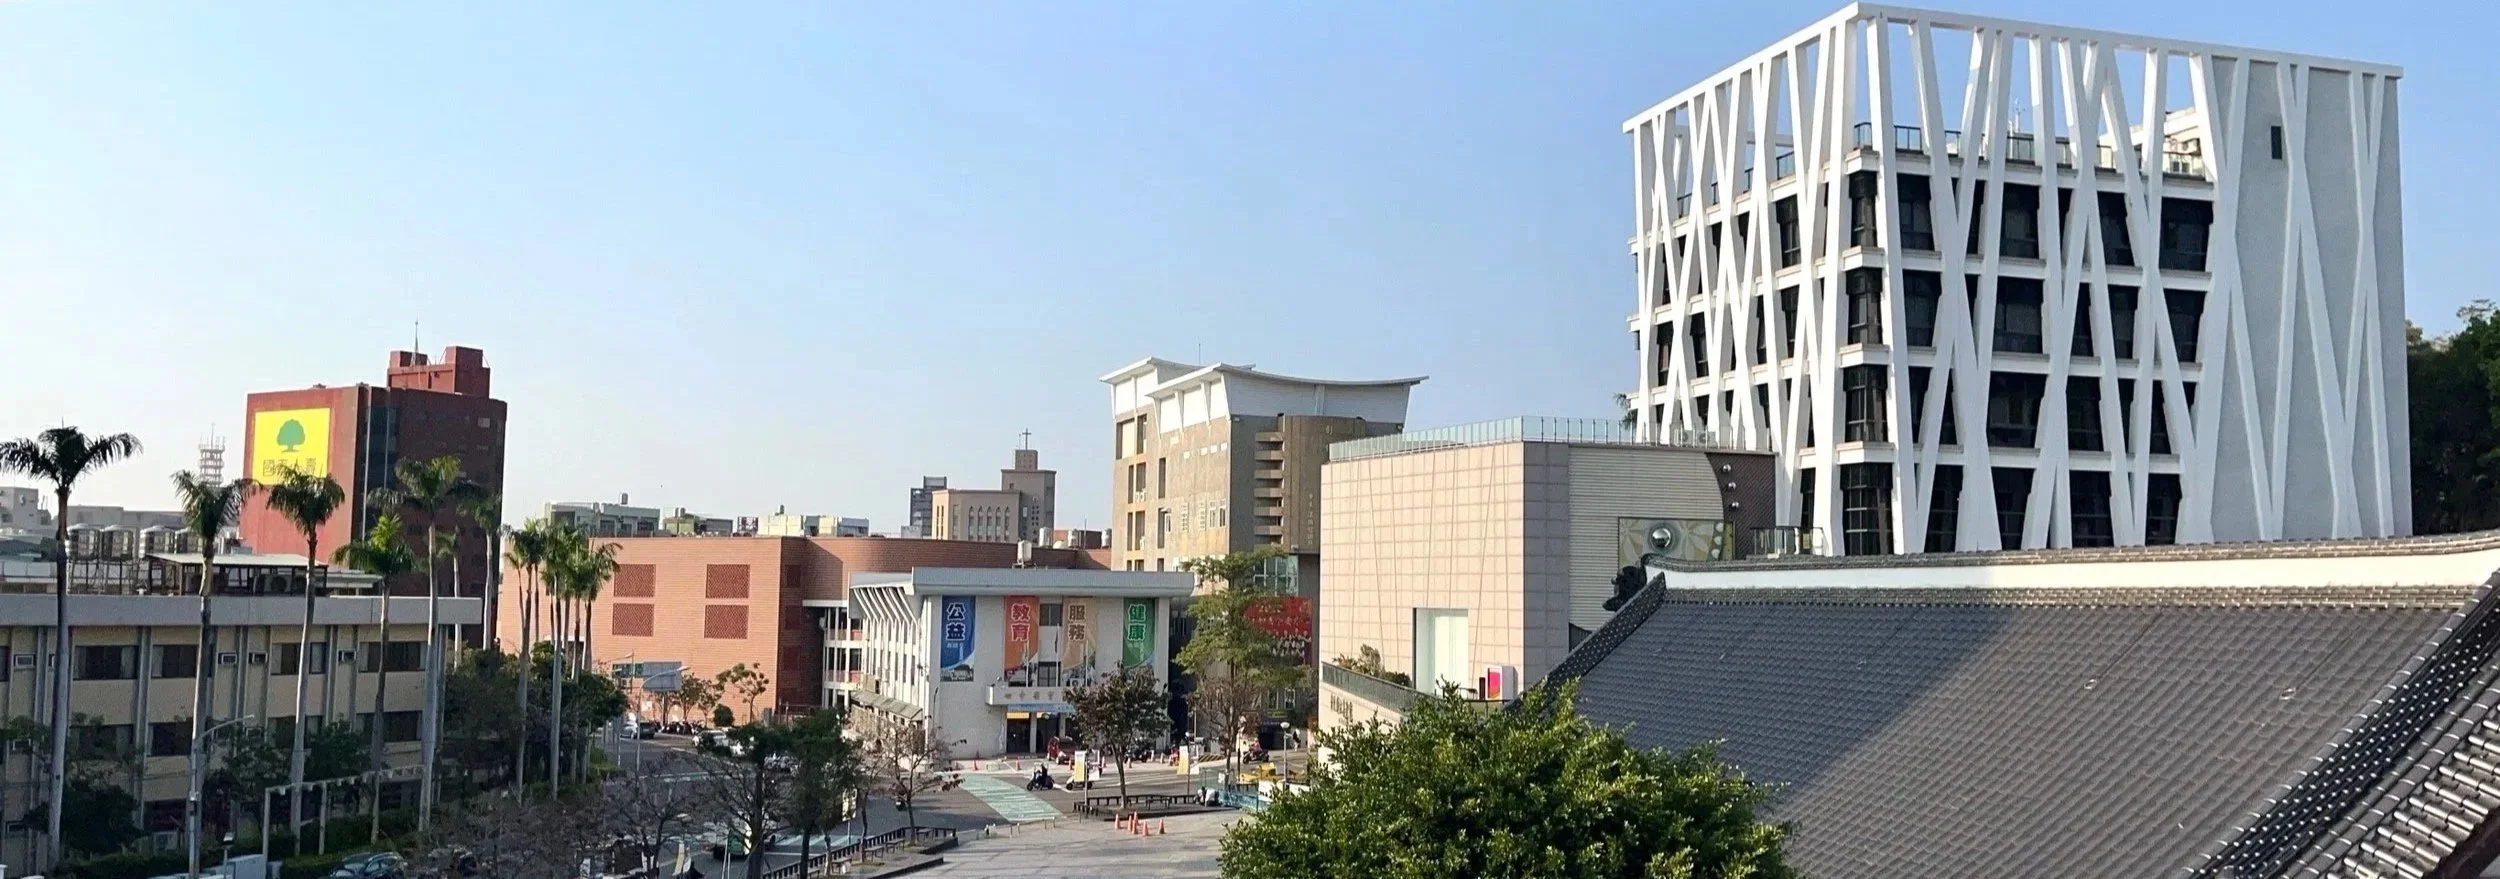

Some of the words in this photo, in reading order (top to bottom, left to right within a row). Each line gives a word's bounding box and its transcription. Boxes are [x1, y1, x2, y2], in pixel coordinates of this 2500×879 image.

[946, 602, 966, 641] 公益
[1011, 602, 1031, 642] 教育
[1068, 604, 1086, 641] 服務
[1128, 603, 1146, 641] 健康
